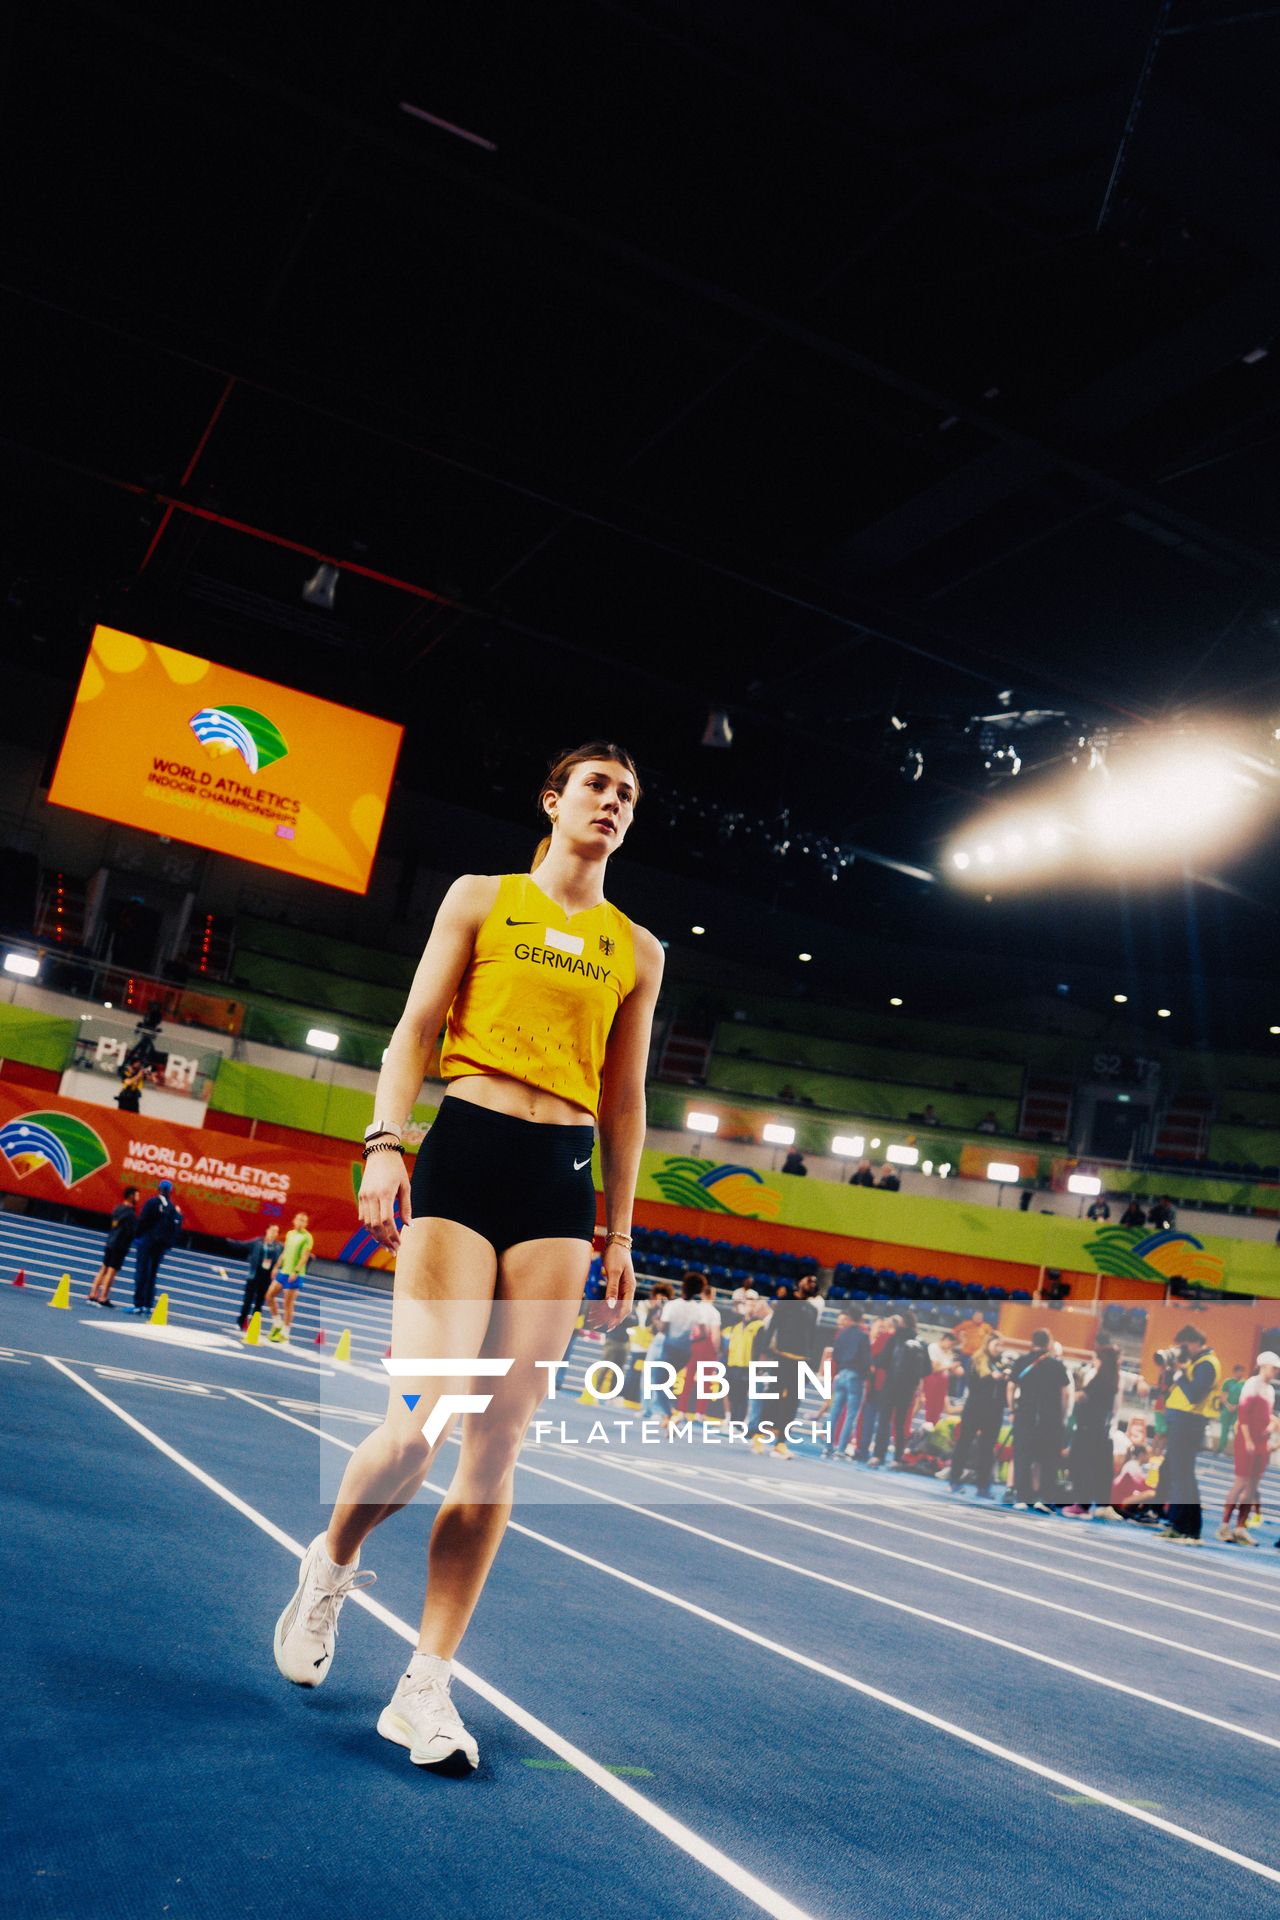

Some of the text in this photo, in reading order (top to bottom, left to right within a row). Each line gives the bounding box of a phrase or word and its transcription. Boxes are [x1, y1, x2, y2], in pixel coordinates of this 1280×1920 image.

[148, 773, 196, 794] INDOOR
[199, 787, 297, 825] CHAMPIONSHIPS
[153, 757, 212, 785] WORLD
[215, 777, 300, 813] ATHLETICS
[514, 943, 611, 983] GERMANY
[96, 1036, 127, 1067] P1
[165, 1053, 198, 1084] R1
[123, 1157, 287, 1204] INDOOR CHAMPIONSHIPS
[128, 1140, 290, 1190] WORLD ATHLETICS
